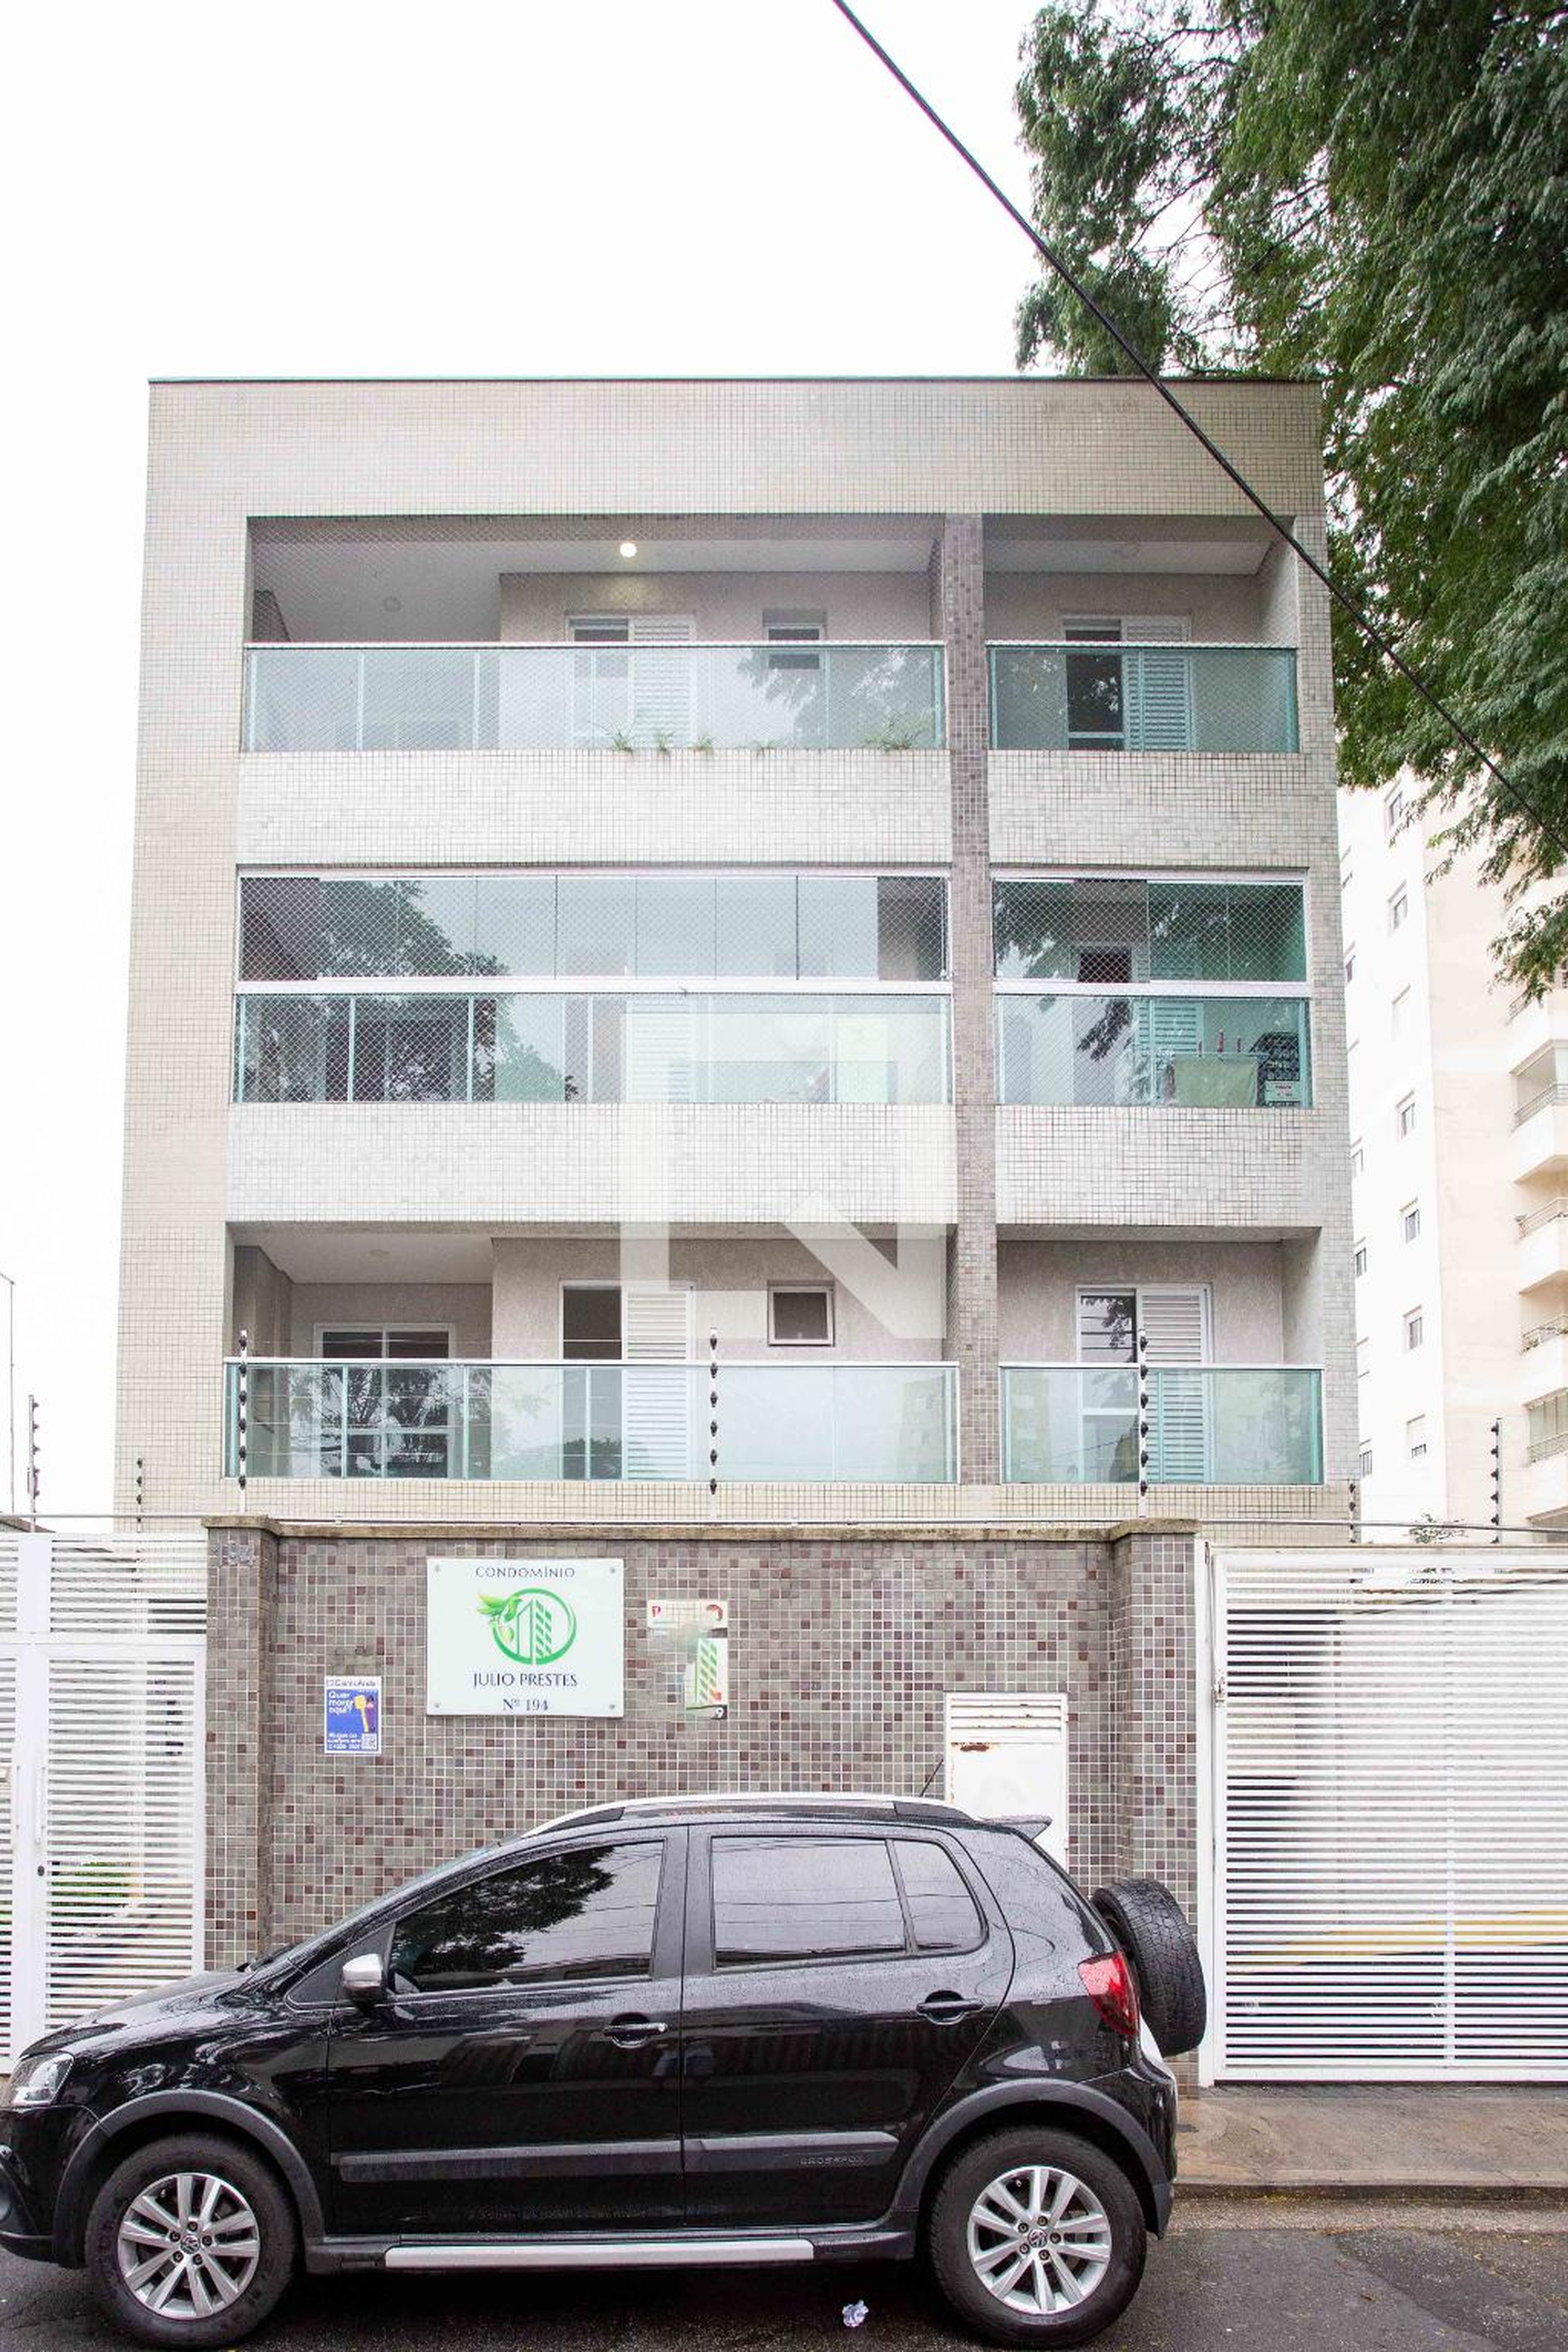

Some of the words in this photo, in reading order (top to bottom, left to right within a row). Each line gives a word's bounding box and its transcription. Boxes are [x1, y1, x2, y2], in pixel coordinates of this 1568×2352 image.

[476, 1565, 575, 1578] CONDOMÍNIO
[474, 1673, 514, 1688] JULIO
[520, 1673, 578, 1686] PRESTES
[526, 1699, 549, 1711] 194
